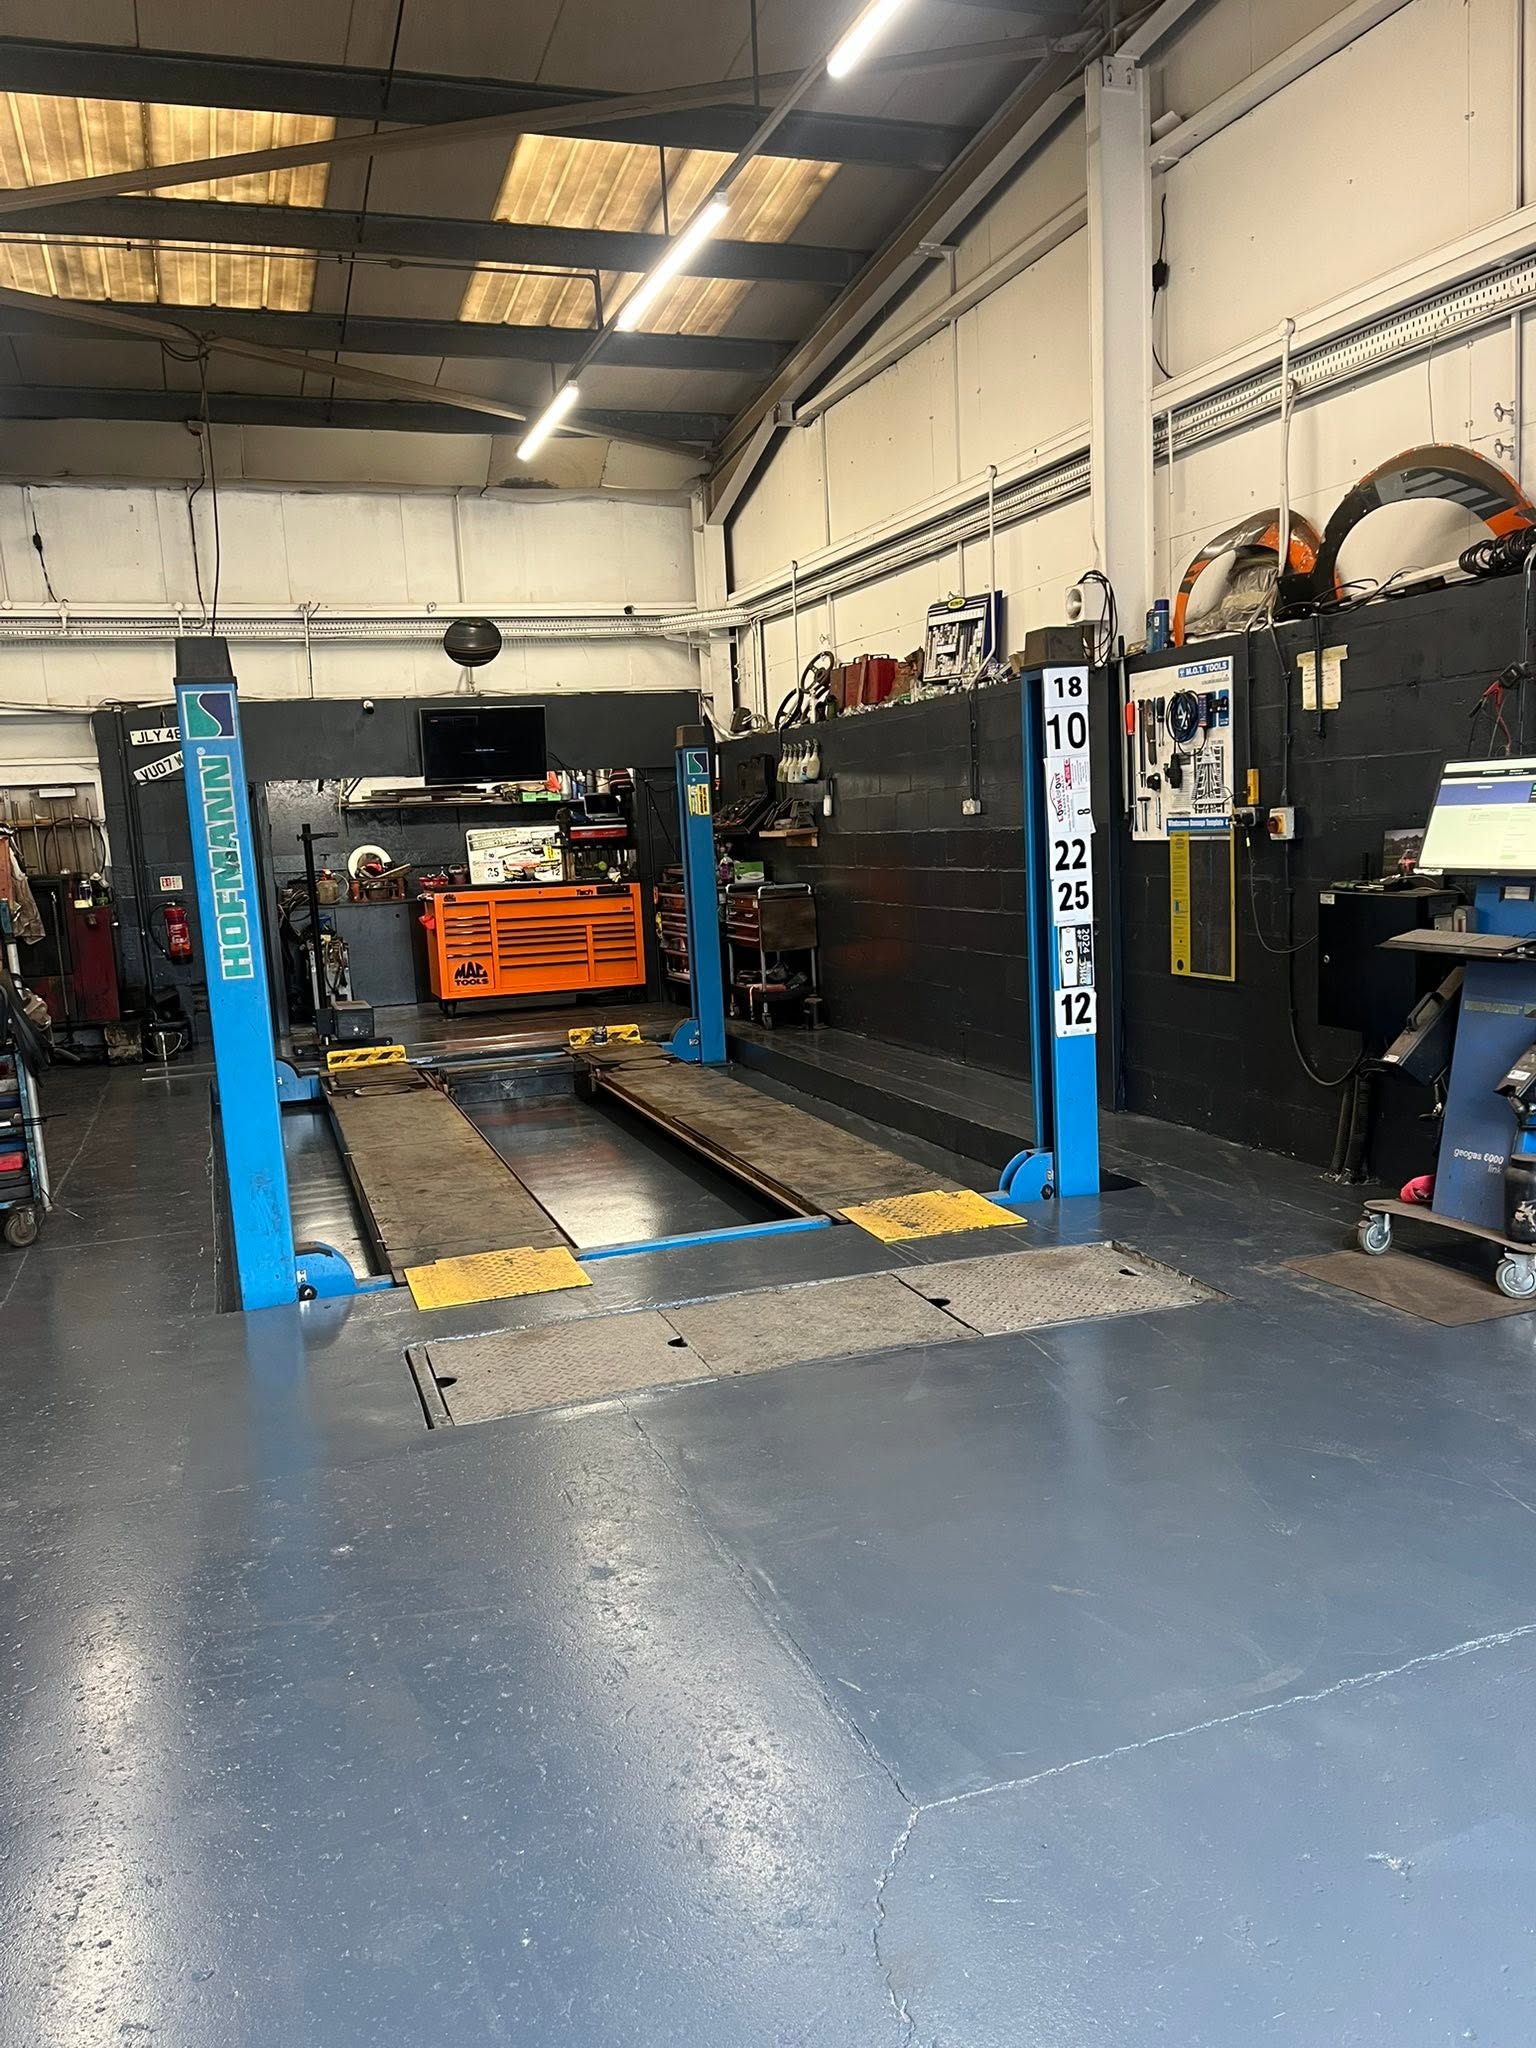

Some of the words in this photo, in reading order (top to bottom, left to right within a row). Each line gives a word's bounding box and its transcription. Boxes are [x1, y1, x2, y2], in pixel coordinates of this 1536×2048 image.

[1205, 661, 1227, 673] TOOLS
[1053, 676, 1082, 698] 18
[137, 730, 161, 743] JLY
[1047, 712, 1086, 749] 10
[1077, 808, 1091, 816] 8
[1054, 839, 1087, 871] 22
[198, 755, 254, 980] HOFMANN
[1058, 881, 1089, 911] 25
[1081, 928, 1090, 954] 2024
[454, 961, 488, 979] MAC
[455, 978, 489, 986] TOOLS
[1061, 992, 1091, 1025] 12
[1453, 1148, 1481, 1160] geogas
